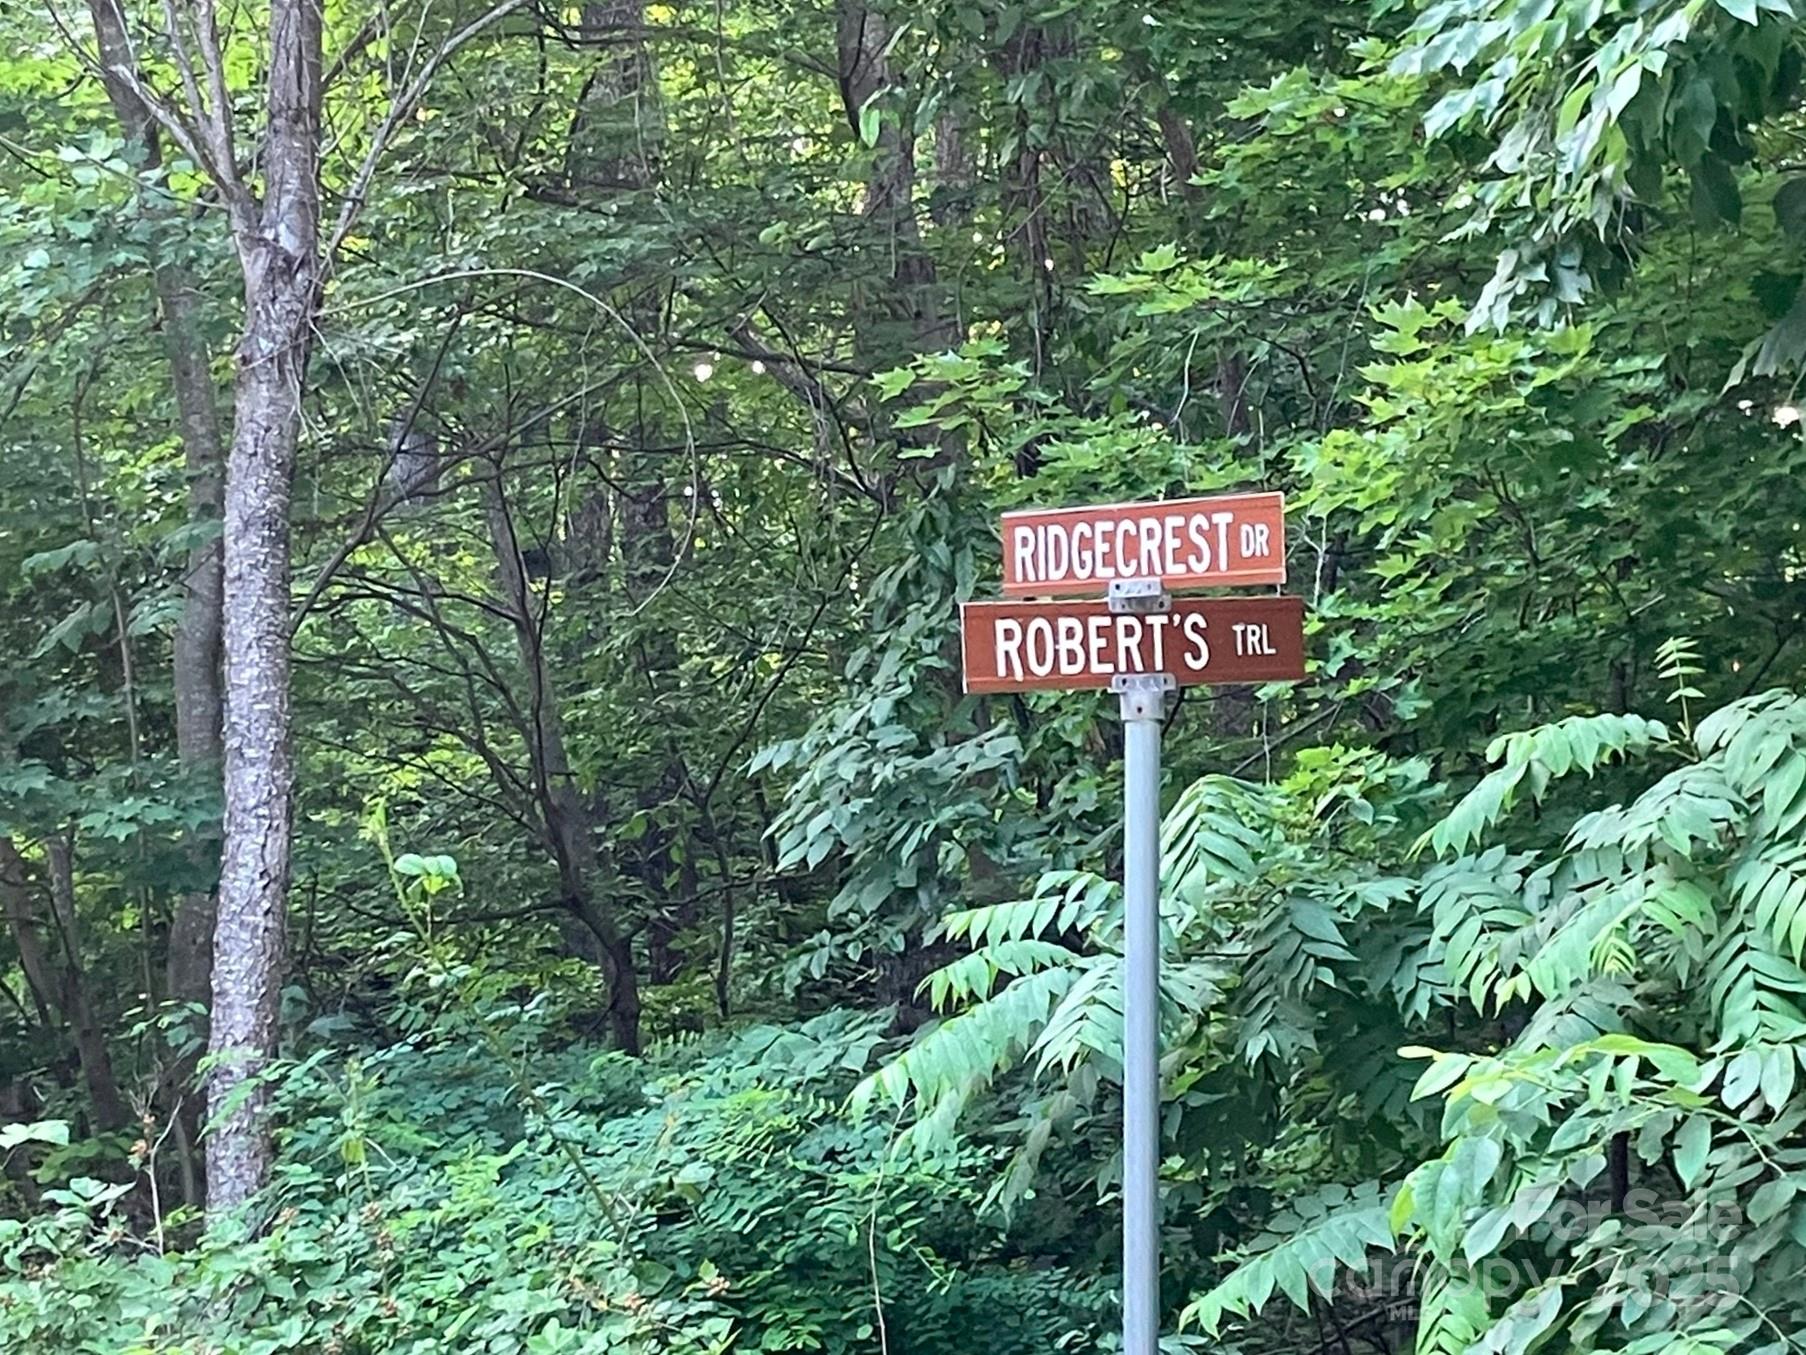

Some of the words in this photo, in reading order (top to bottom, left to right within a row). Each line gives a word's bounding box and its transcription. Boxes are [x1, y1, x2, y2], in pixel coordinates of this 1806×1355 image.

[1013, 512, 1234, 582] RIDGECREST
[1240, 523, 1270, 558] DR
[995, 612, 1211, 682] ROBERT'S
[1232, 623, 1276, 656] TRL
